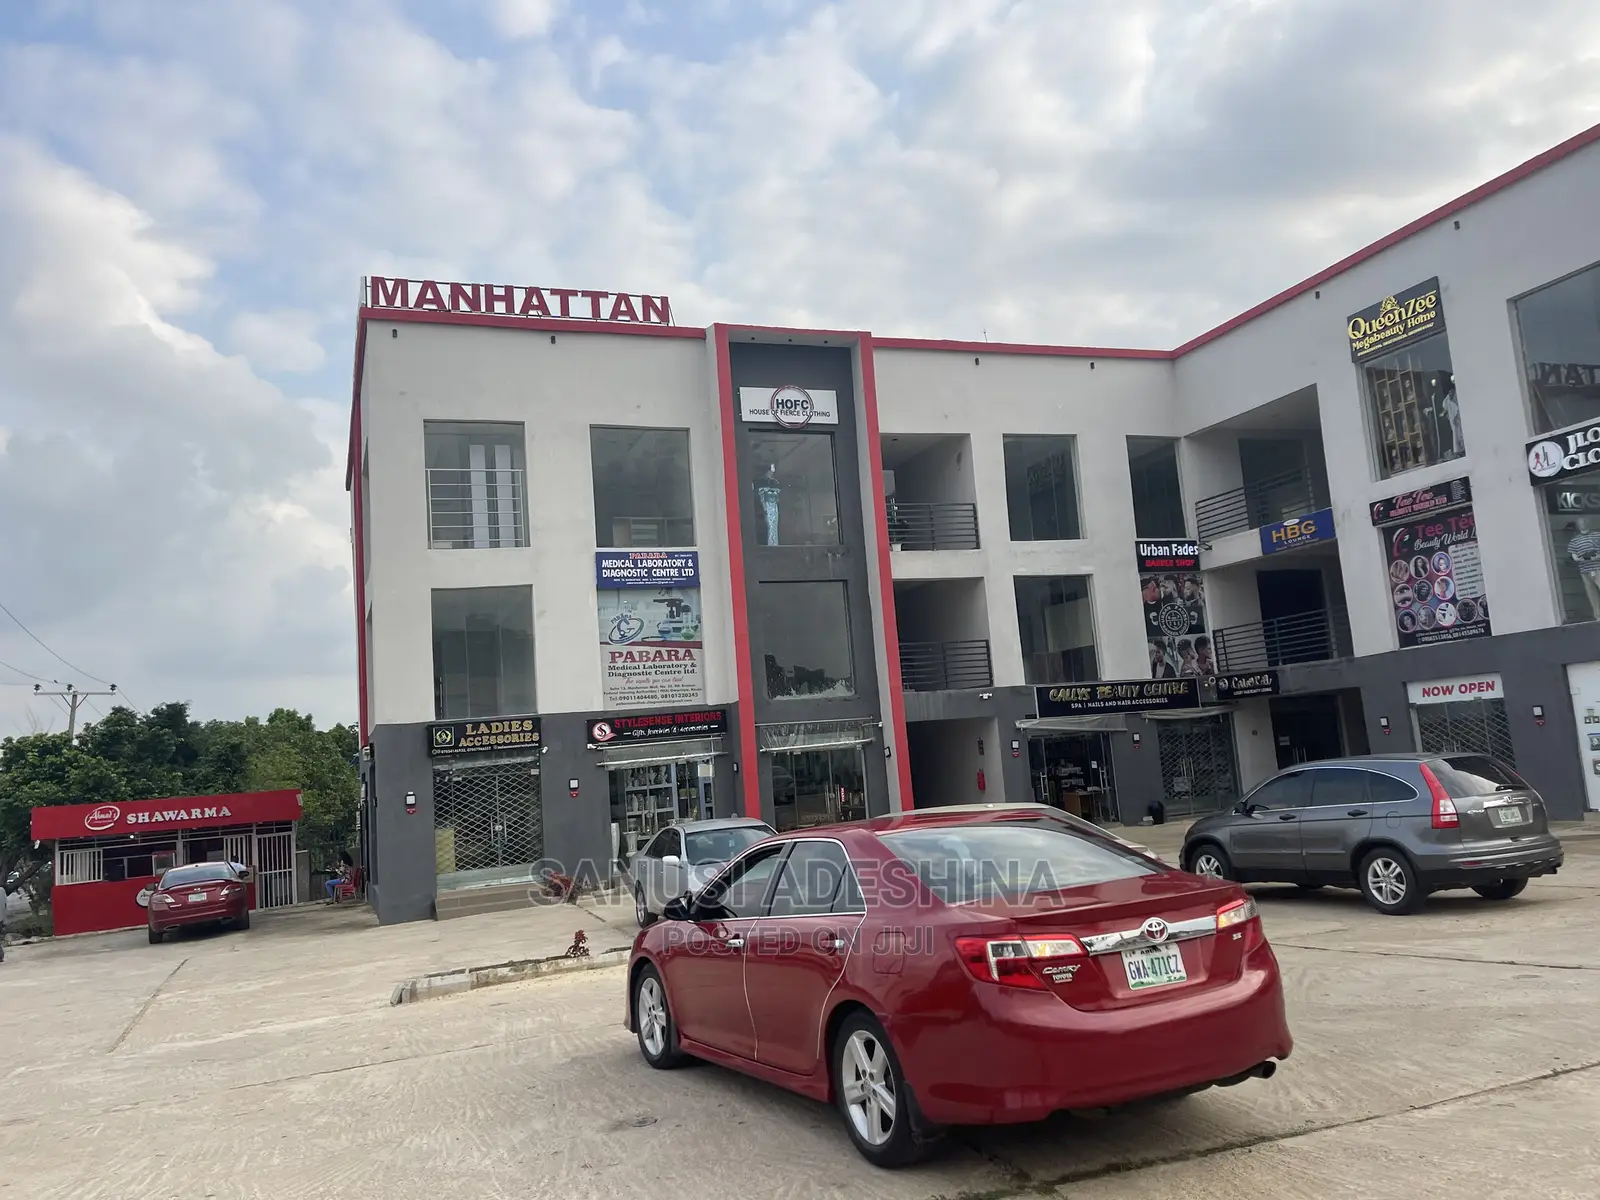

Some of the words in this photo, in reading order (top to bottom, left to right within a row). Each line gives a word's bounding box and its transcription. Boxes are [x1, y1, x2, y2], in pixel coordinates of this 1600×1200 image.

[371, 276, 669, 323] MANHATTAN
[1352, 322, 1406, 351] Megabeauty
[1407, 310, 1436, 328] Home
[776, 398, 809, 410] HOFC
[1393, 493, 1413, 508] Tee
[1412, 489, 1434, 503] Tee
[1272, 520, 1316, 543] HBG
[1415, 523, 1444, 538] Tee
[1283, 534, 1312, 545] LOUNGE
[1414, 537, 1441, 551] Beauty
[1441, 529, 1469, 545] World
[1140, 543, 1170, 556] Urban
[1172, 543, 1199, 556] Fades
[602, 559, 634, 568] MEDICAL
[638, 559, 685, 568] LABORATORY
[688, 559, 694, 567] &
[602, 568, 648, 577] DIAGNOSTIC
[652, 568, 679, 577] CENTRE
[682, 568, 694, 576] LTD
[609, 649, 696, 663] PABARA
[1049, 687, 1091, 702] CALLYS
[1096, 684, 1140, 699] BEAUTY
[1143, 682, 1189, 697] CENTRE
[1422, 685, 1454, 698] NOW
[1458, 681, 1495, 693] OPEN
[1132, 697, 1168, 705] ACCESSORIES
[466, 720, 533, 735] LADIES
[614, 715, 673, 729] STYLESENSE
[675, 711, 722, 724] INTERIORS
[459, 732, 540, 747] ACCESSORIES
[127, 806, 231, 824] SHAWARMA
[1052, 972, 1073, 980] TOYOTA
